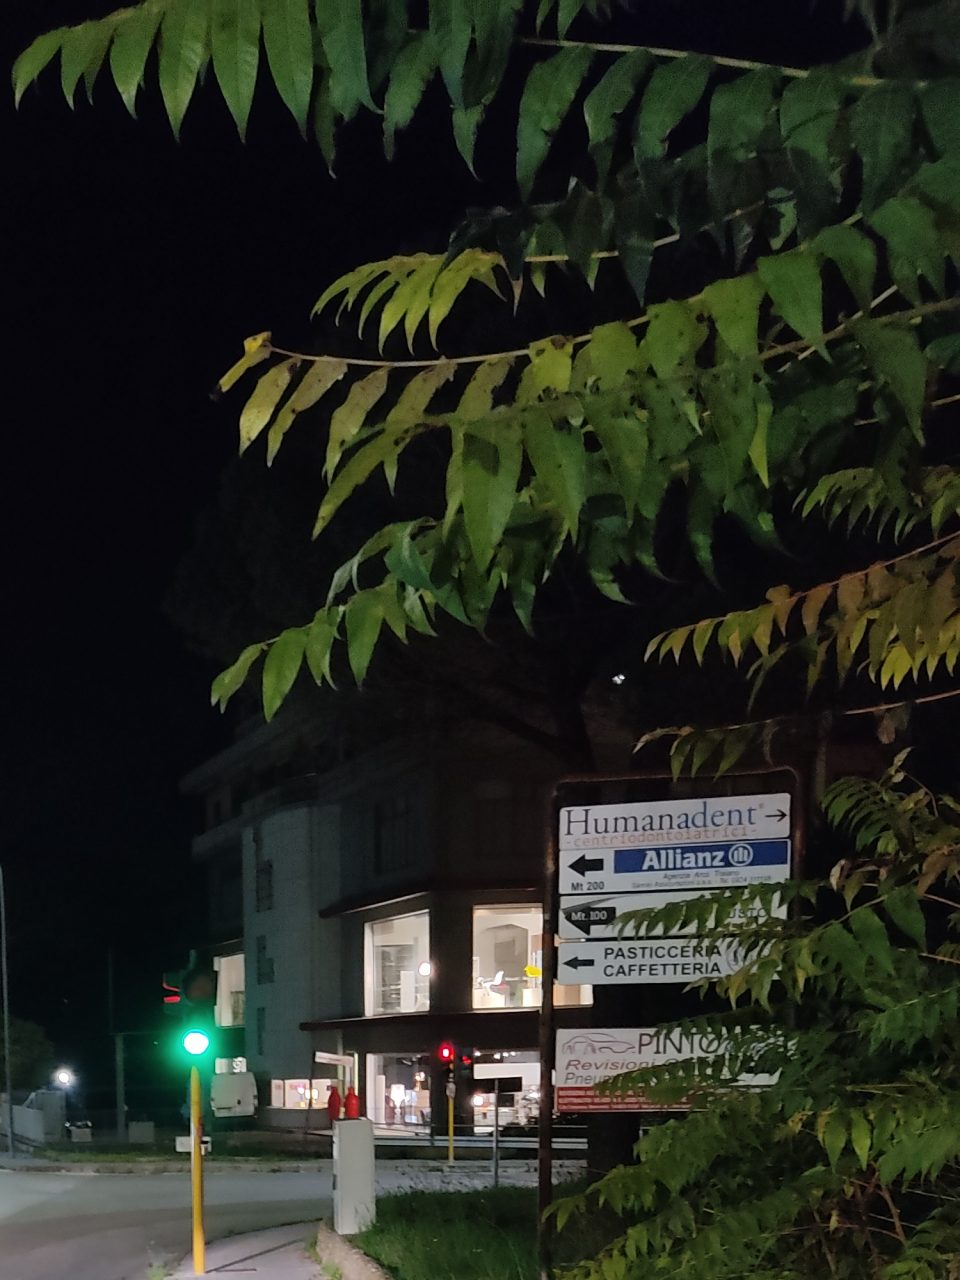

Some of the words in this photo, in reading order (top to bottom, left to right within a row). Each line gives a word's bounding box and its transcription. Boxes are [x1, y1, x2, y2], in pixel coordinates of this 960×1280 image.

[565, 801, 757, 836] Humanadent
[642, 848, 725, 871] Allianz
[571, 881, 584, 892] Mt
[587, 881, 605, 891] 200
[590, 910, 608, 921] 100
[604, 945, 722, 960] PASTICCERIA
[603, 962, 722, 977] CAFFETTERIA
